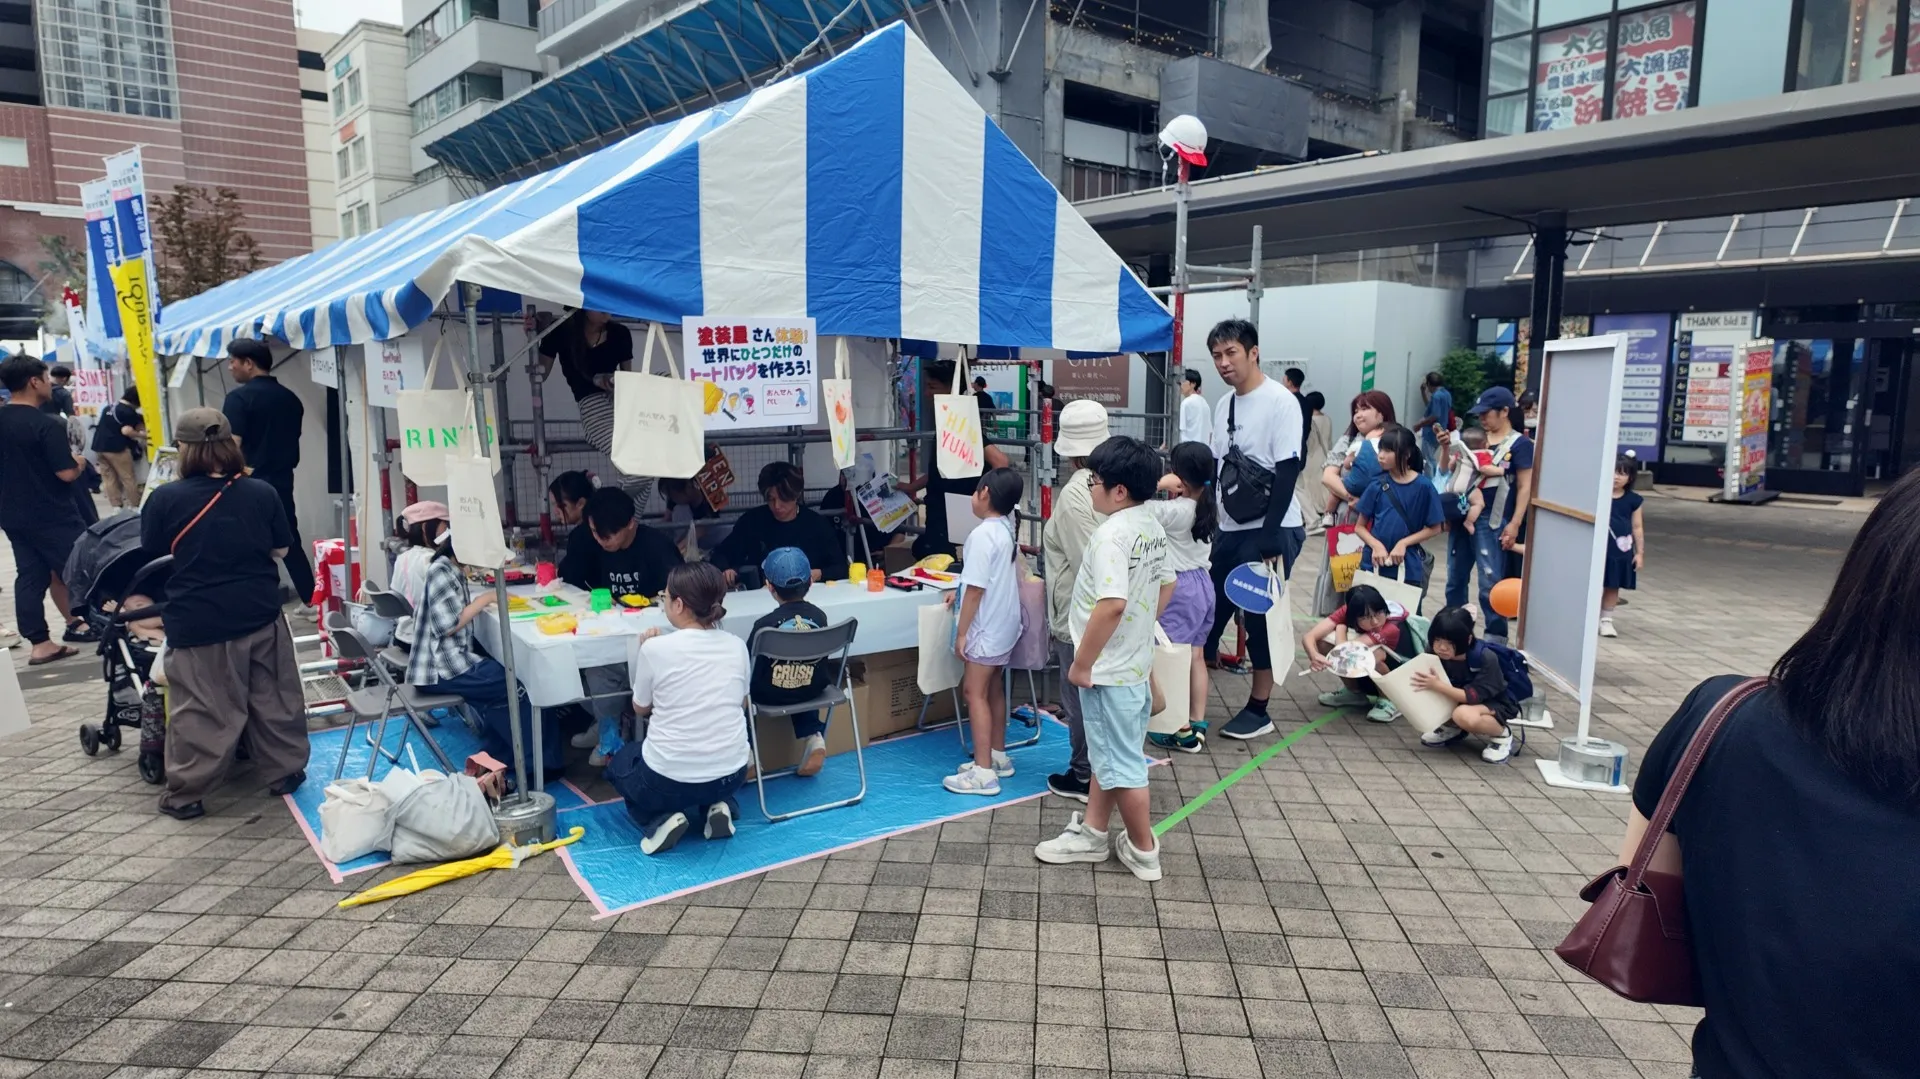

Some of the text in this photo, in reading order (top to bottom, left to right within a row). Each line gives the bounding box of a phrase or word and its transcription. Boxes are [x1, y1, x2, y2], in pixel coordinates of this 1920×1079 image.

[1686, 316, 1720, 327] THANK
[702, 345, 803, 364] 世界にひとつだけの
[772, 664, 815, 681] CRUSH
